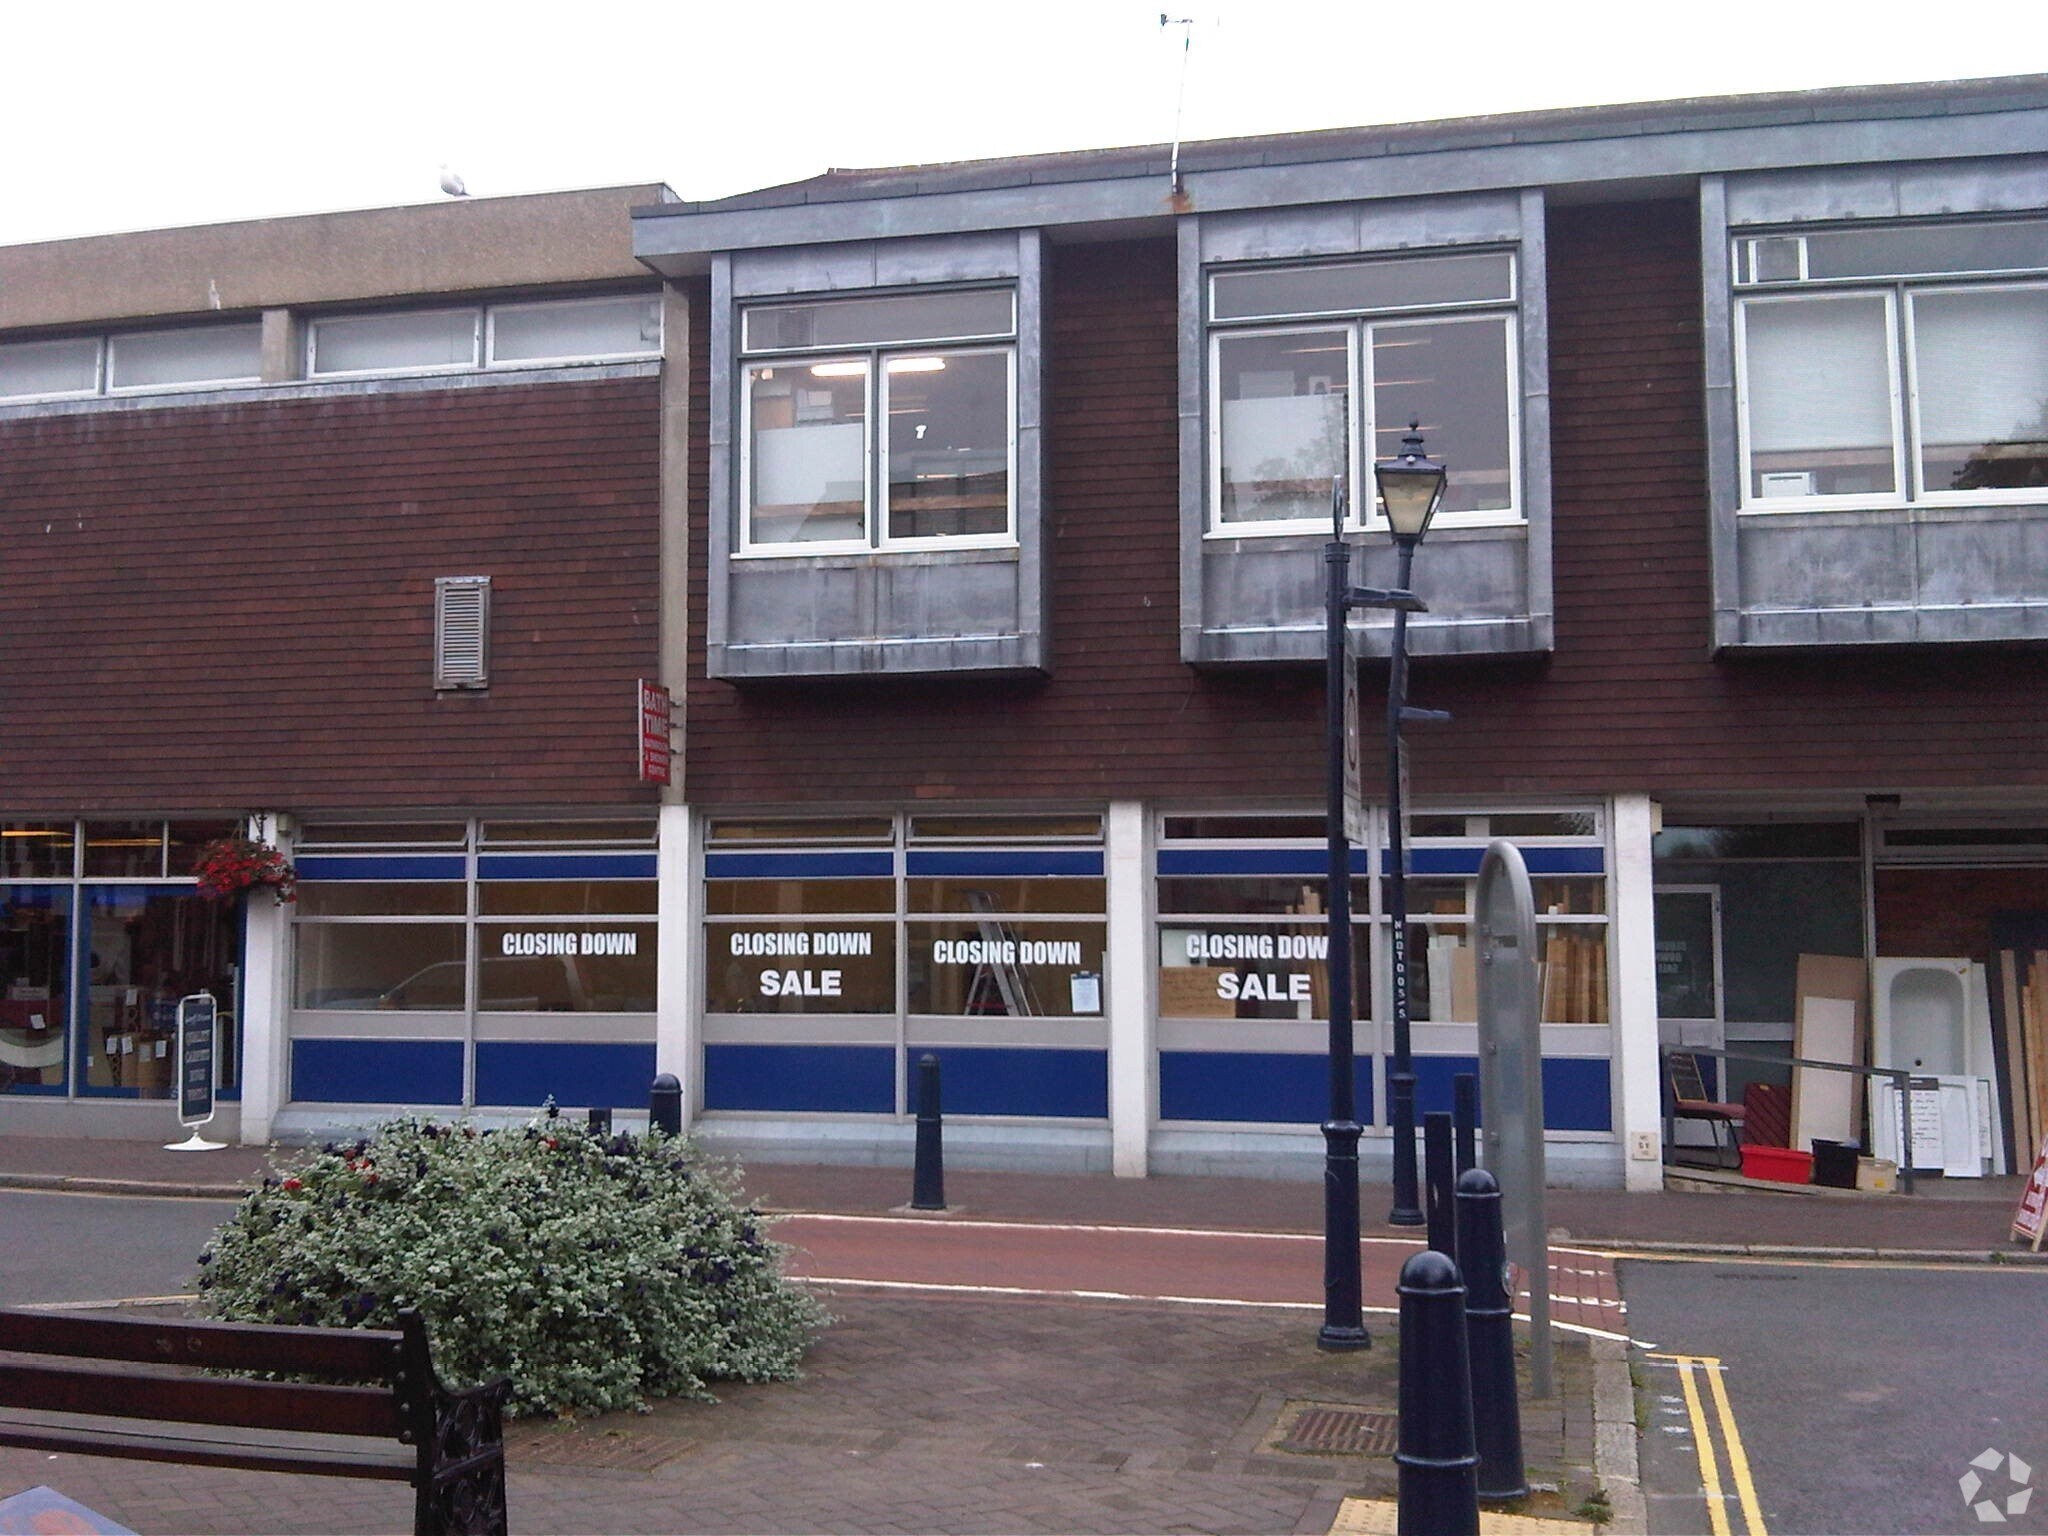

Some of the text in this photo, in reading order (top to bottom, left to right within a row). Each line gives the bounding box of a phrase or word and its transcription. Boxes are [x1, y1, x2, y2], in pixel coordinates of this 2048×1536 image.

[502, 932, 637, 955] CLOSING DOWN
[730, 932, 871, 956] CLOSING DOWN
[933, 940, 1081, 966] CLOSING DOWN
[1186, 934, 1329, 960] CLOSING DOW
[760, 969, 842, 996] SALE
[1216, 972, 1312, 1001] SALE
